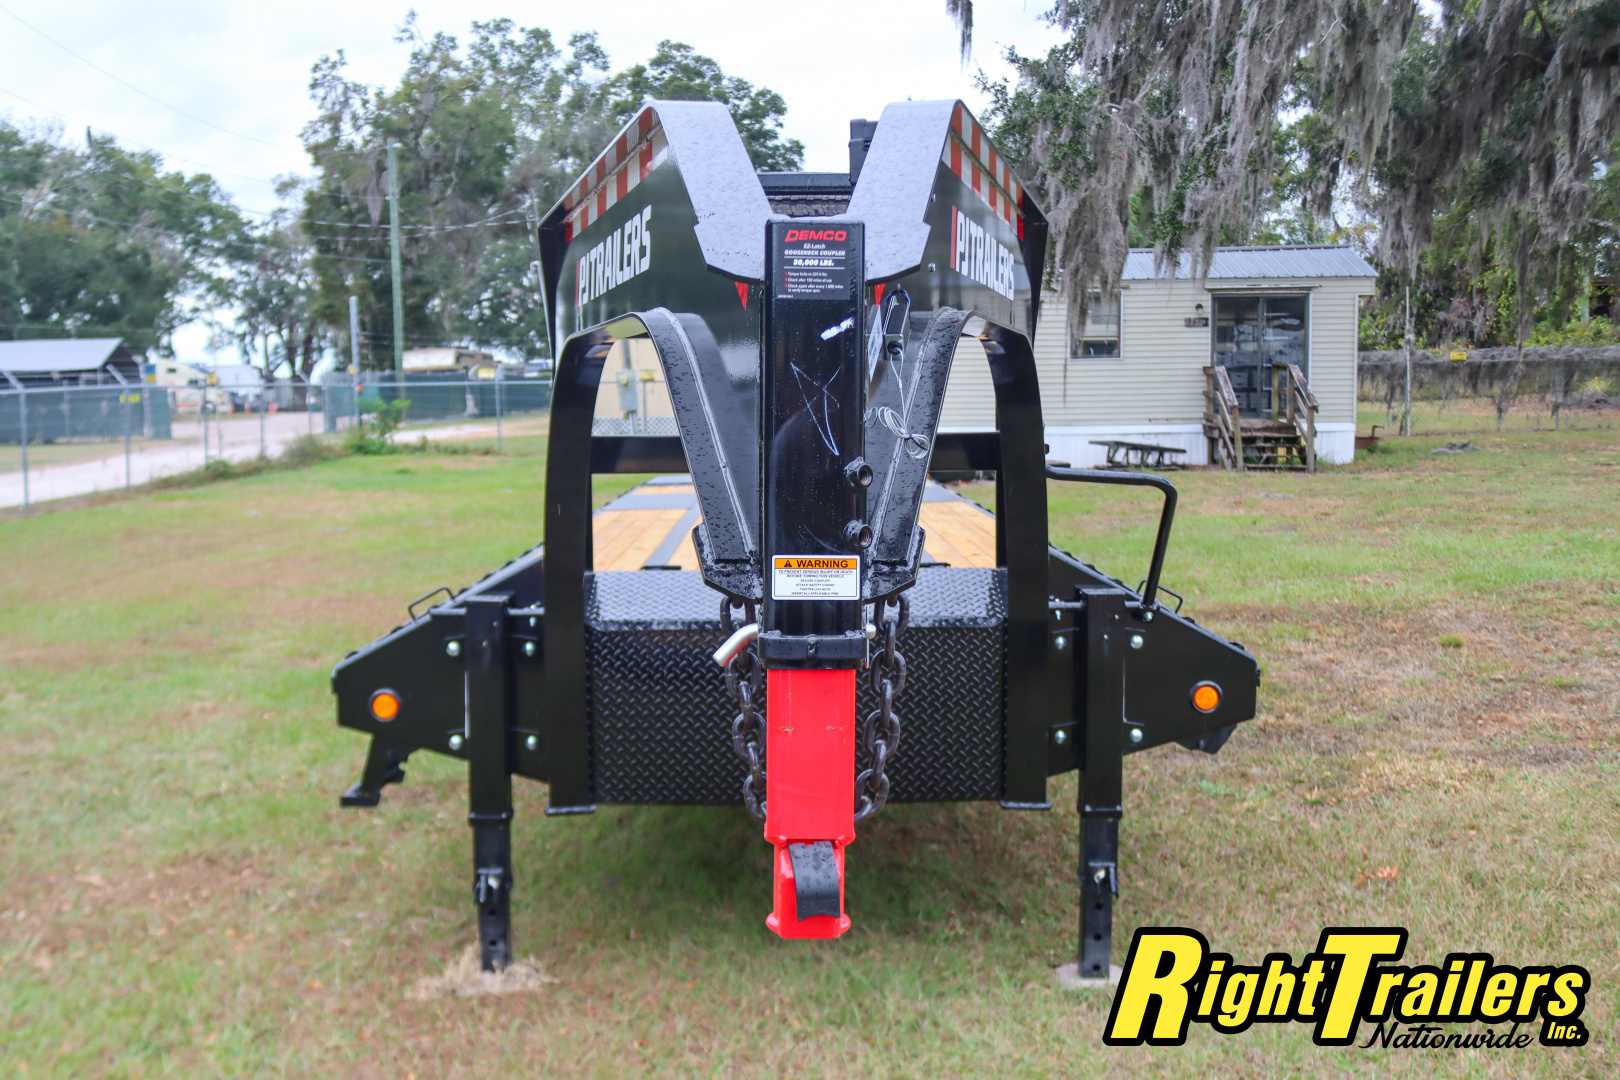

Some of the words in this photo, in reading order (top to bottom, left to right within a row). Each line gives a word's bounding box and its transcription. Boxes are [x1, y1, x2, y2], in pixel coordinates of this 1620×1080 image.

[784, 229, 847, 243] DEMCO
[590, 204, 652, 300] TRAILERS
[793, 259, 819, 267] 30,000
[970, 220, 1015, 301] TRAILERS
[796, 560, 849, 568] WARNING
